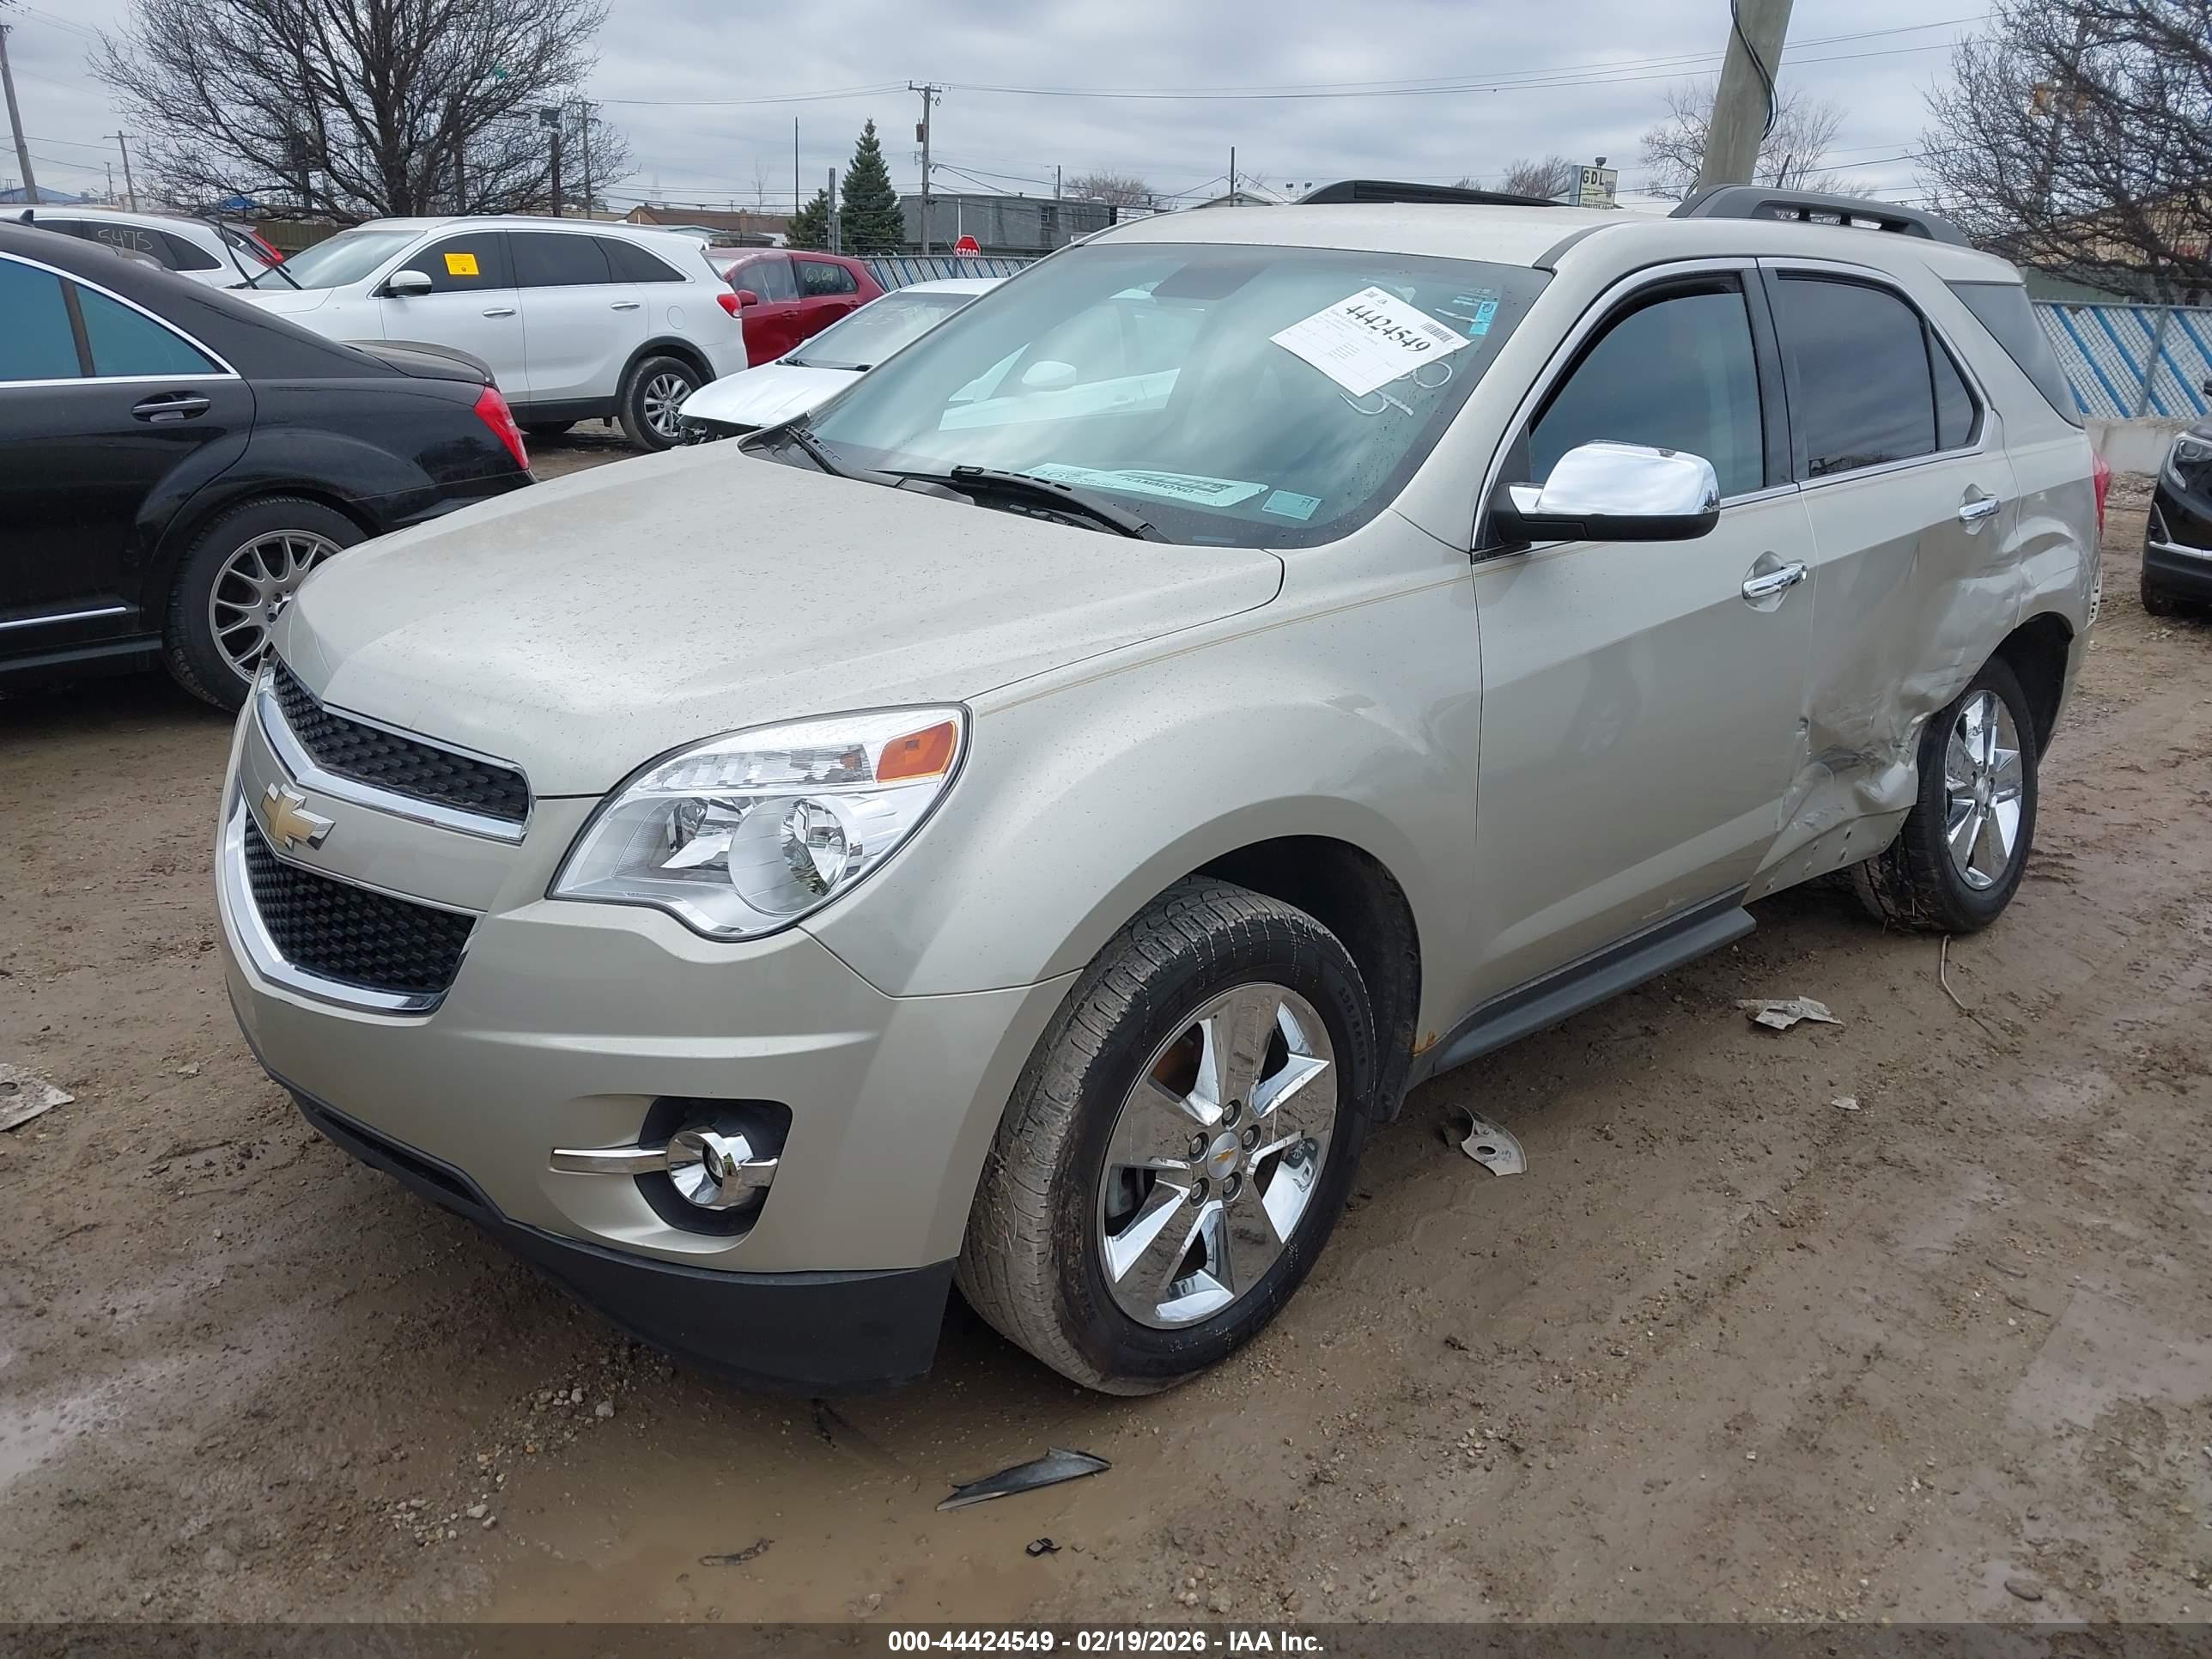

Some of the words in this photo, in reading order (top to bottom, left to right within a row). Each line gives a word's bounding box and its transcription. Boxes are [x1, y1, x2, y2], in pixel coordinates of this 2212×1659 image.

[1583, 170, 1605, 185] GDL
[956, 247, 978, 257] STOP
[1345, 305, 1431, 352] 44424549
[1121, 477, 1195, 494] HAMMOND
